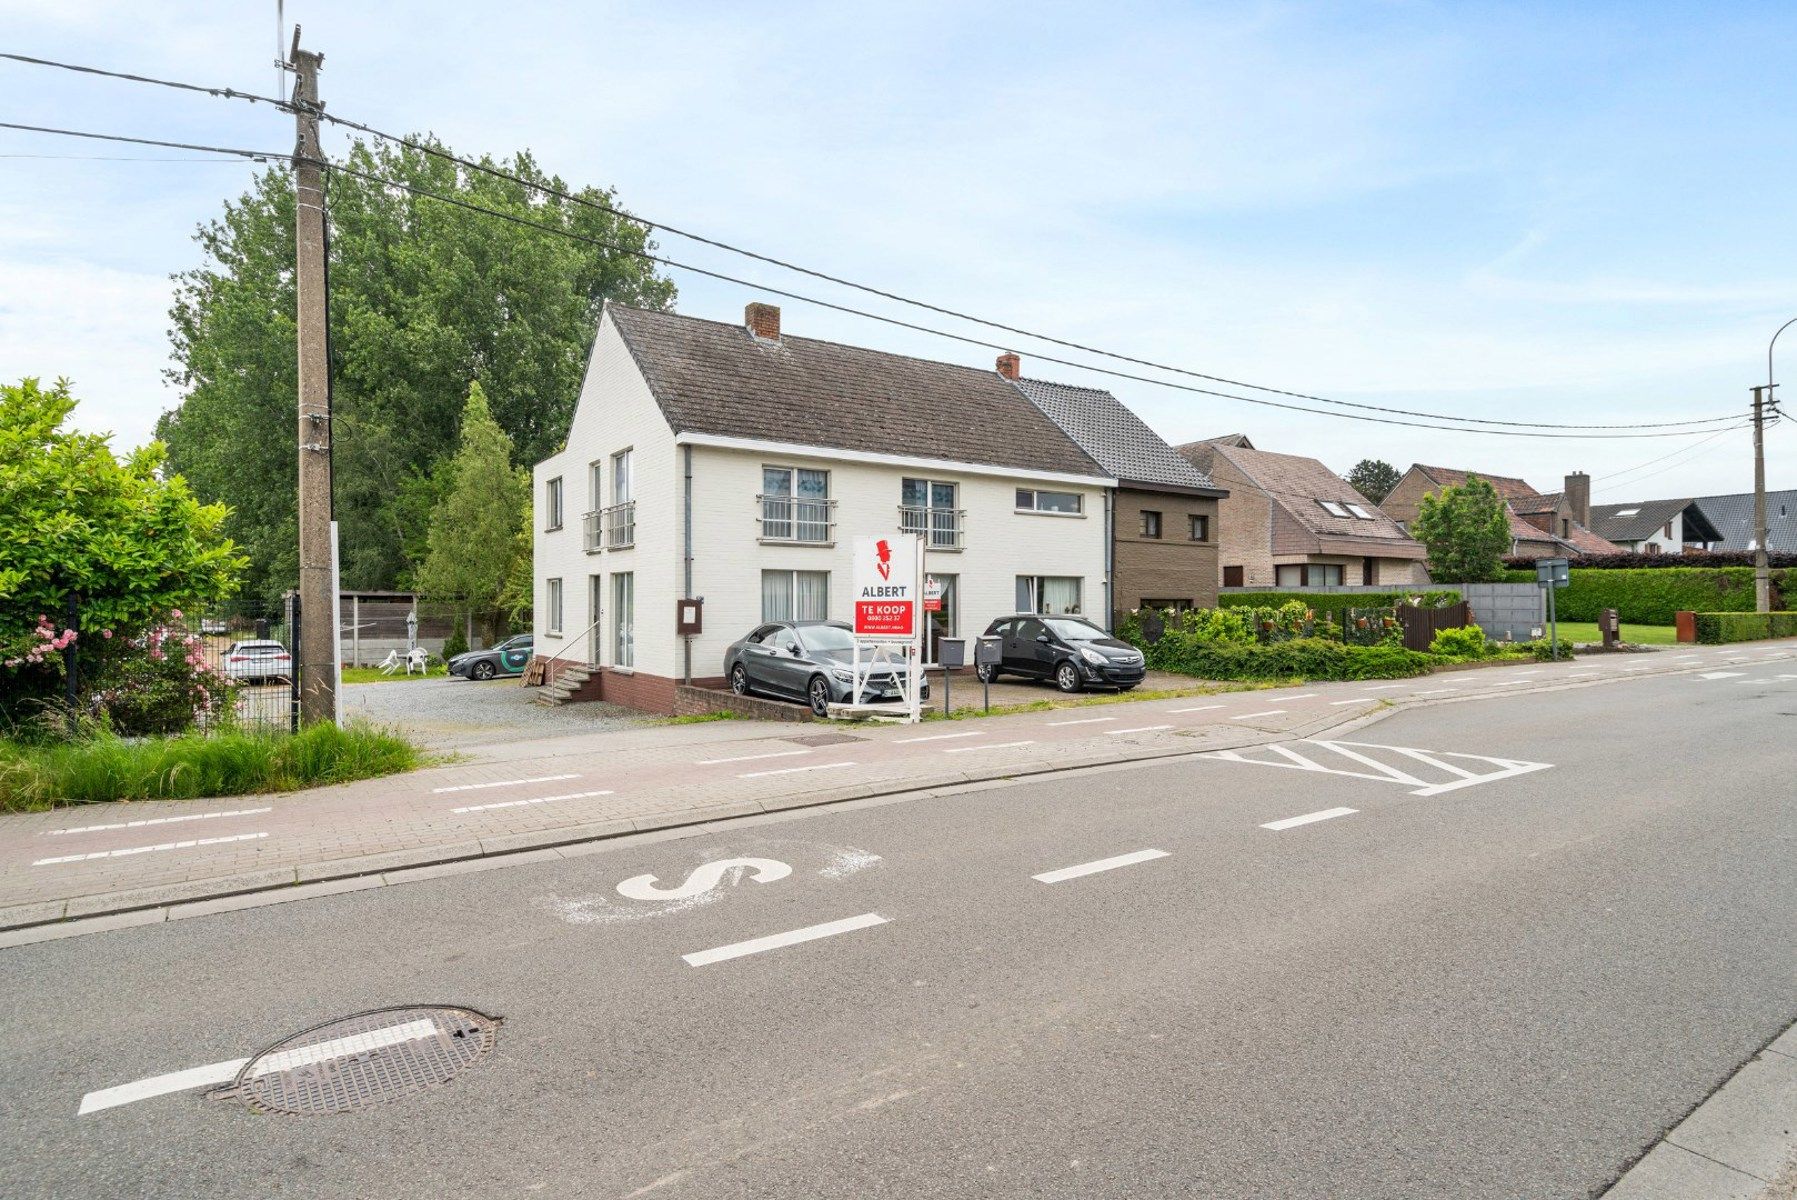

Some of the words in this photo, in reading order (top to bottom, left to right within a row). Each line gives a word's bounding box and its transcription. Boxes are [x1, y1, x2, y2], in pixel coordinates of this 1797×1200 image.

[862, 586, 907, 597] ALBERT
[861, 605, 874, 615] TE
[876, 605, 906, 615] KOOP
